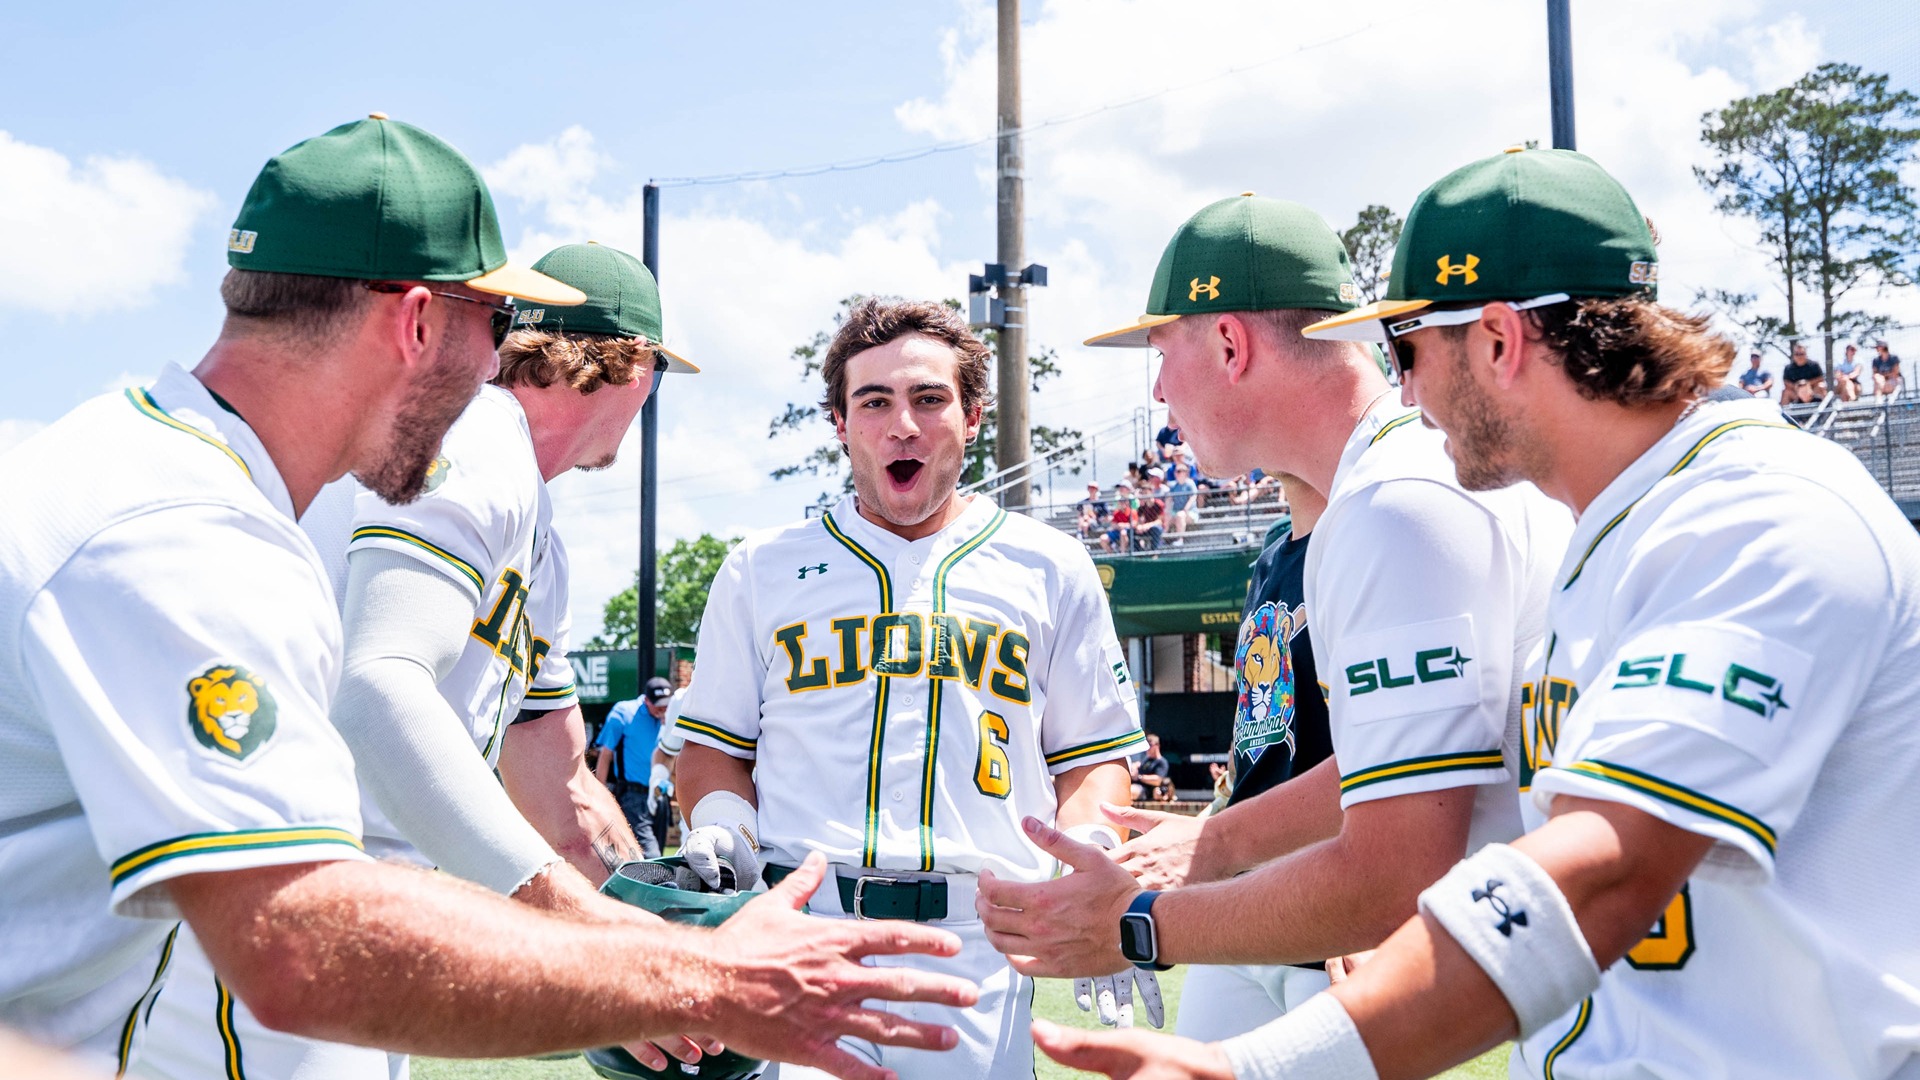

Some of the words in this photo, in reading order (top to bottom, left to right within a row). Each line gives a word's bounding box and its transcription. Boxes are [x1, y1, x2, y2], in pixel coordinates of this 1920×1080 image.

[1201, 612, 1241, 624] ESTATE
[775, 611, 1032, 706] LIONS
[1345, 646, 1459, 697] SLC
[1612, 653, 1777, 718] SLC
[973, 709, 1012, 800] 6
